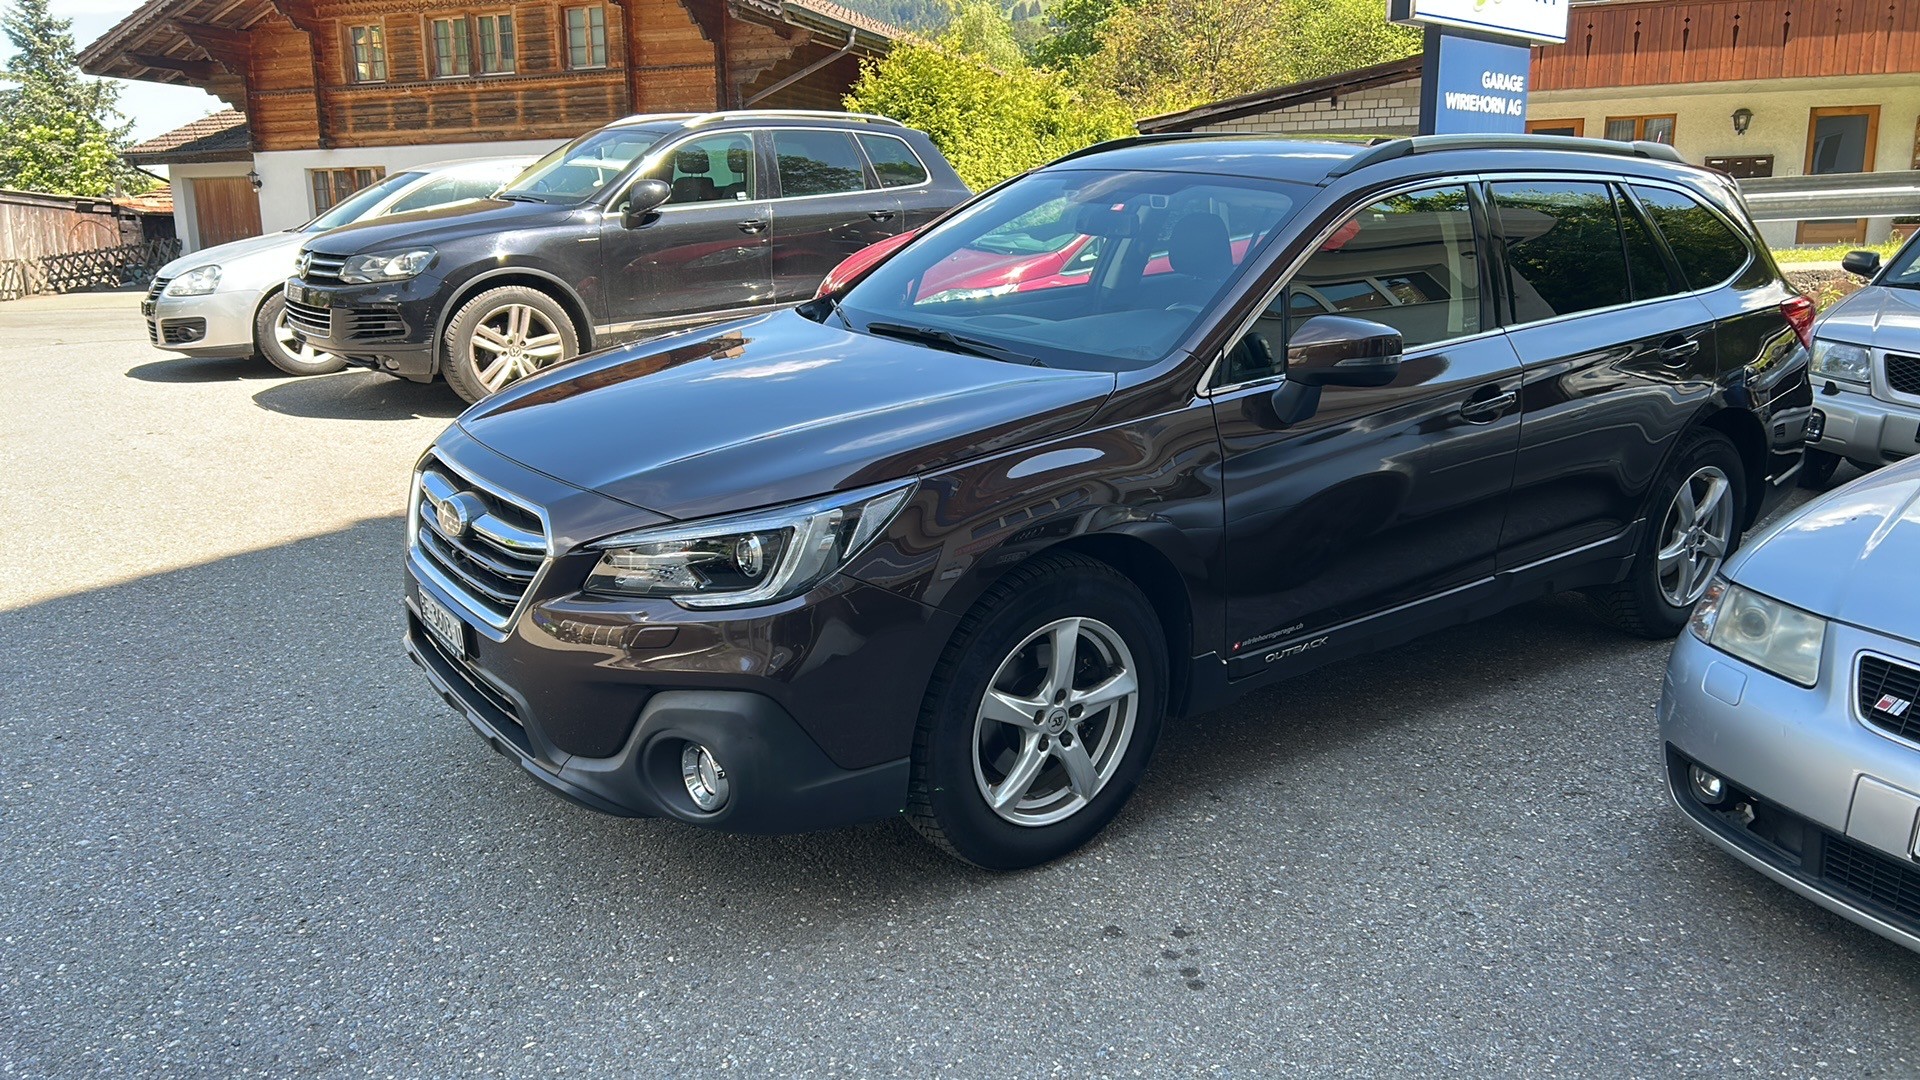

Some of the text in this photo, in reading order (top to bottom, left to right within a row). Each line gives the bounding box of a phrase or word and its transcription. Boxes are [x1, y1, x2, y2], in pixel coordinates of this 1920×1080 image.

[1482, 71, 1524, 92] GARAGE
[1445, 92, 1522, 116] WIRIEHORN AG
[1265, 636, 1328, 662] OUTBACK
